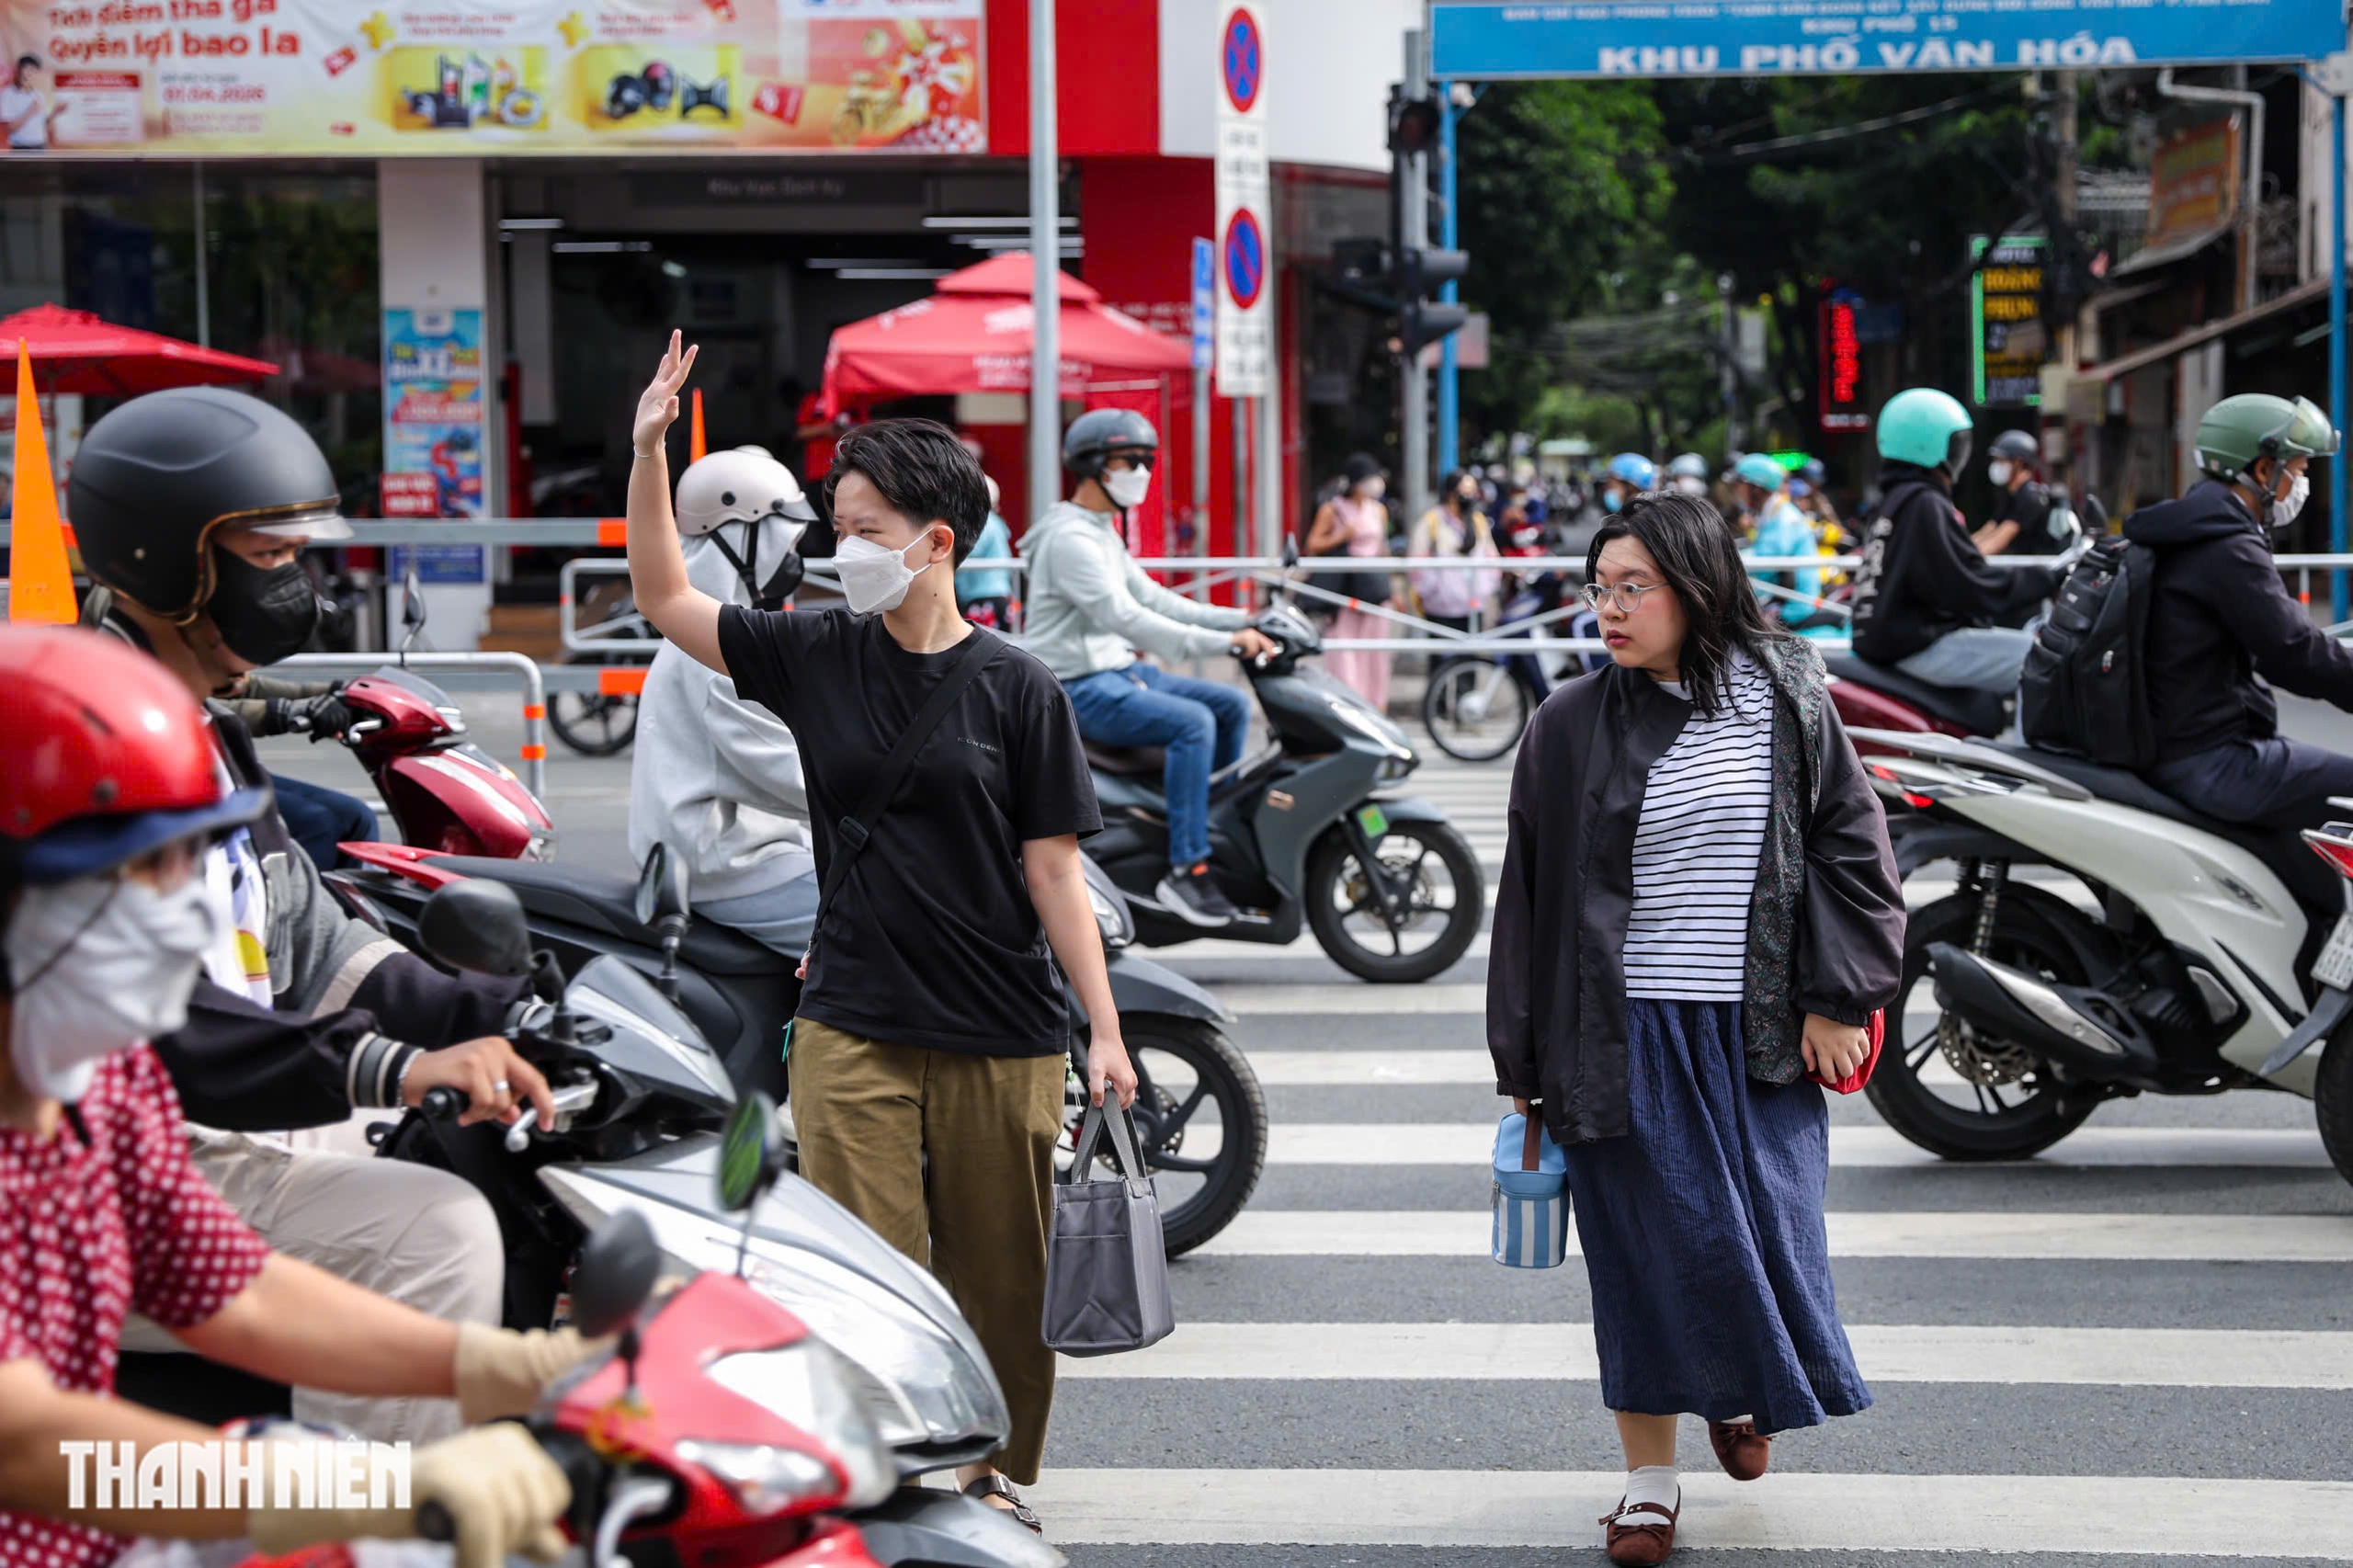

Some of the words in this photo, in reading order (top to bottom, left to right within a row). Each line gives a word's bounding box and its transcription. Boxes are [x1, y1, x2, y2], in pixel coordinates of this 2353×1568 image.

[50, 32, 128, 62] Quyền
[134, 28, 172, 63] lợi
[181, 30, 250, 56] bao
[259, 26, 301, 56] la
[1597, 45, 1718, 74] KHU
[1741, 34, 1859, 73] PHỐ
[1877, 36, 1995, 68] VĂN
[2018, 30, 2137, 65] HÓA
